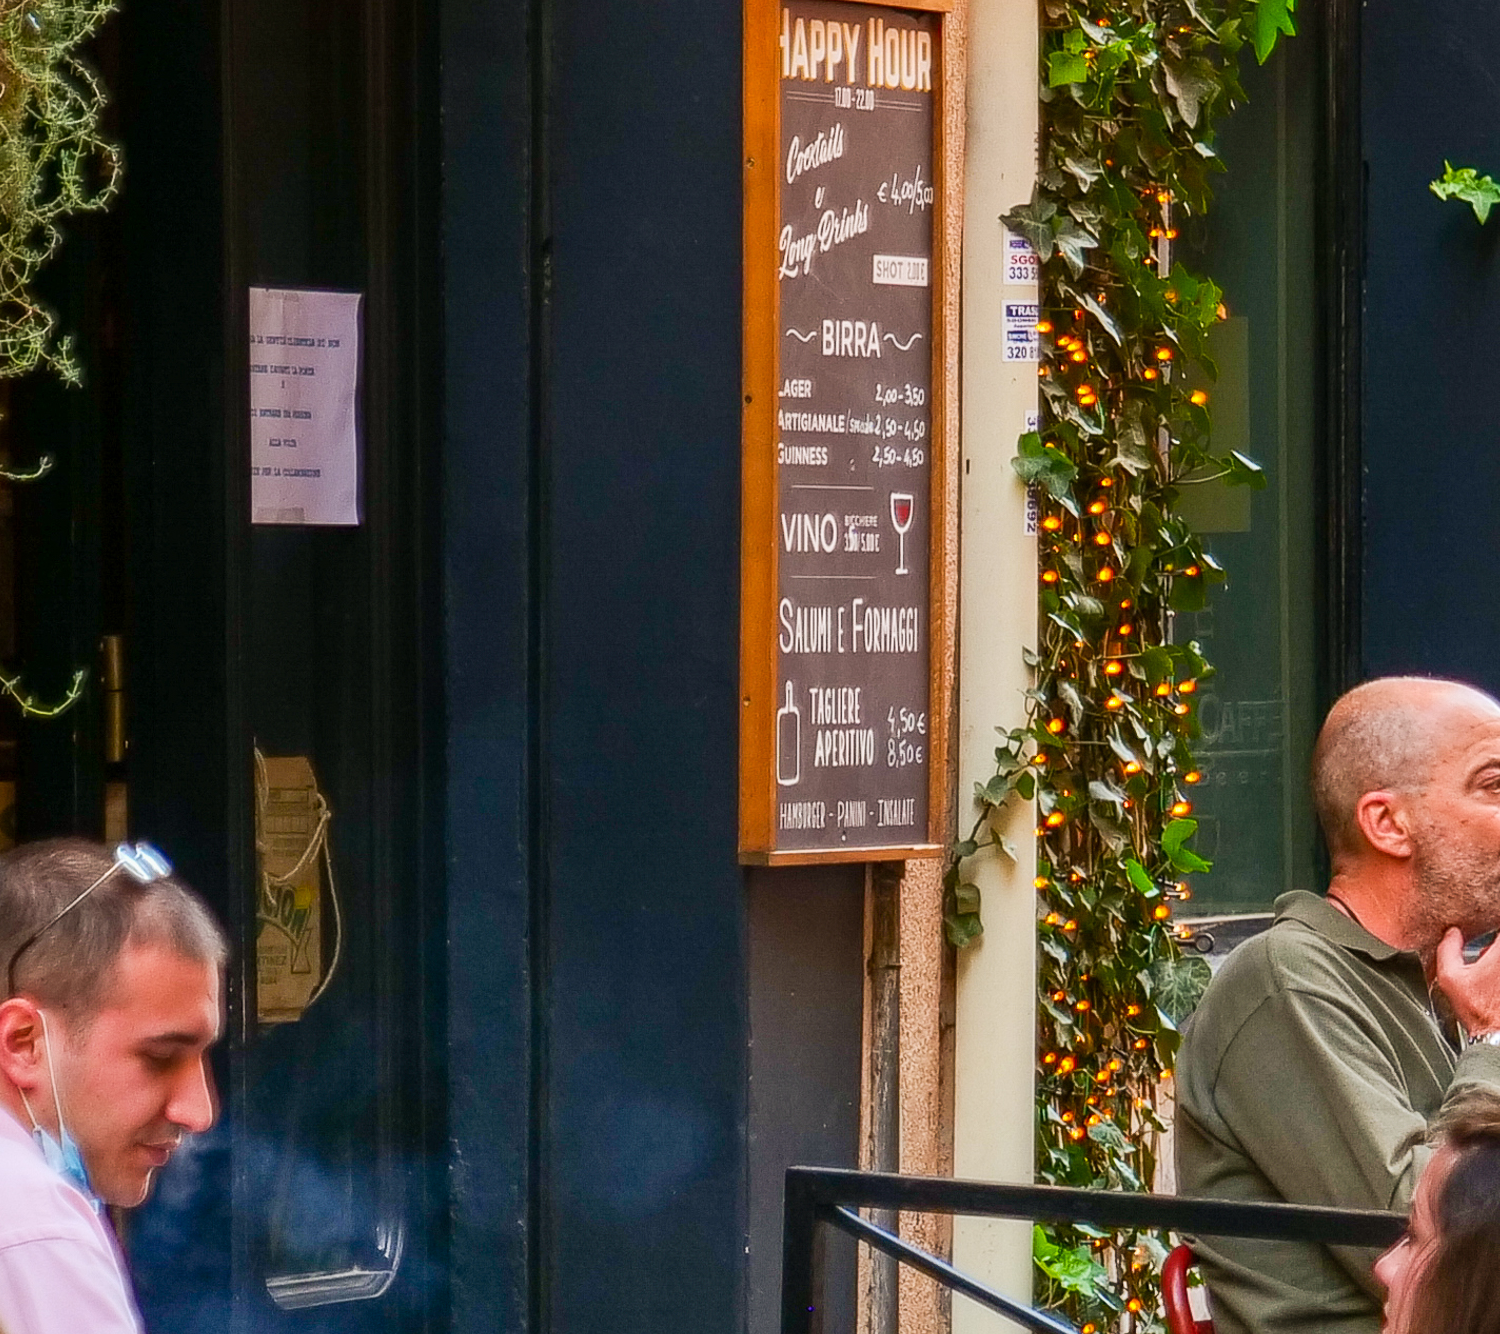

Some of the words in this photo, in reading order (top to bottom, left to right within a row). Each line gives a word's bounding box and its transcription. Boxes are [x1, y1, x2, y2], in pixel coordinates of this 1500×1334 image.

[780, 8, 861, 84] HAPPY
[867, 17, 932, 92] HOUR
[786, 122, 844, 185] Cocktails
[778, 224, 818, 281] Long
[817, 198, 869, 253] Drinks
[876, 260, 903, 280] SHOT
[1009, 266, 1029, 280] 333
[1010, 254, 1039, 265] SGO
[822, 319, 881, 358] BIRRA
[1007, 345, 1027, 359] 320
[778, 442, 828, 466] GUINNESS
[781, 513, 838, 553] VINO
[779, 597, 832, 654] SALUMI
[837, 606, 845, 653] E
[852, 597, 919, 654] FORMAGGI
[809, 687, 861, 725] TAGLIERE
[814, 729, 875, 767] APERITIVO
[779, 801, 826, 830] HAMBURGER
[837, 800, 866, 828] PANINI
[877, 798, 915, 827] INSALATE
